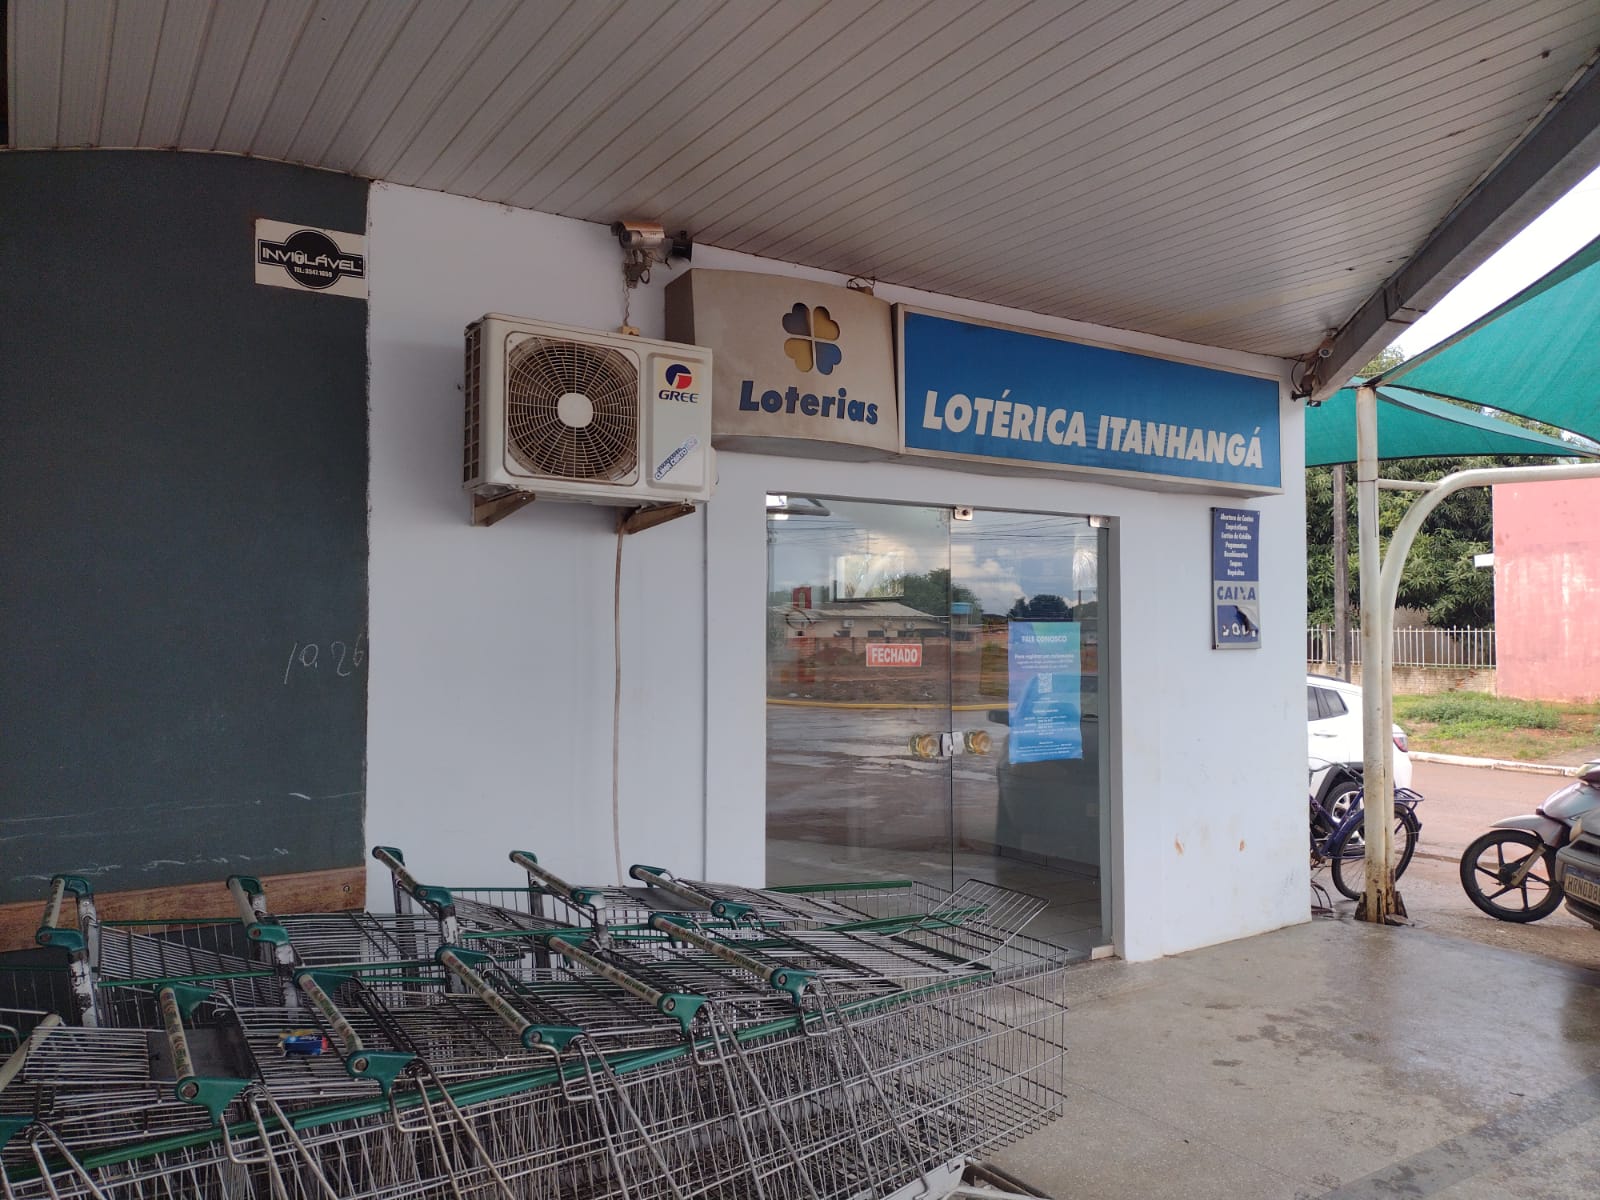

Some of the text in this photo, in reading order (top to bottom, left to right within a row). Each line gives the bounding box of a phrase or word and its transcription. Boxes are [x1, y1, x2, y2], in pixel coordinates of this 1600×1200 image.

[262, 247, 362, 273] INVIOLÁVEL
[659, 389, 699, 403] GREE
[739, 380, 878, 425] Loterias
[923, 390, 1263, 469] LOTÉRICA ITANHANGÁ
[1036, 635, 1067, 643] CONOSCO
[871, 647, 918, 664] FECHADO
